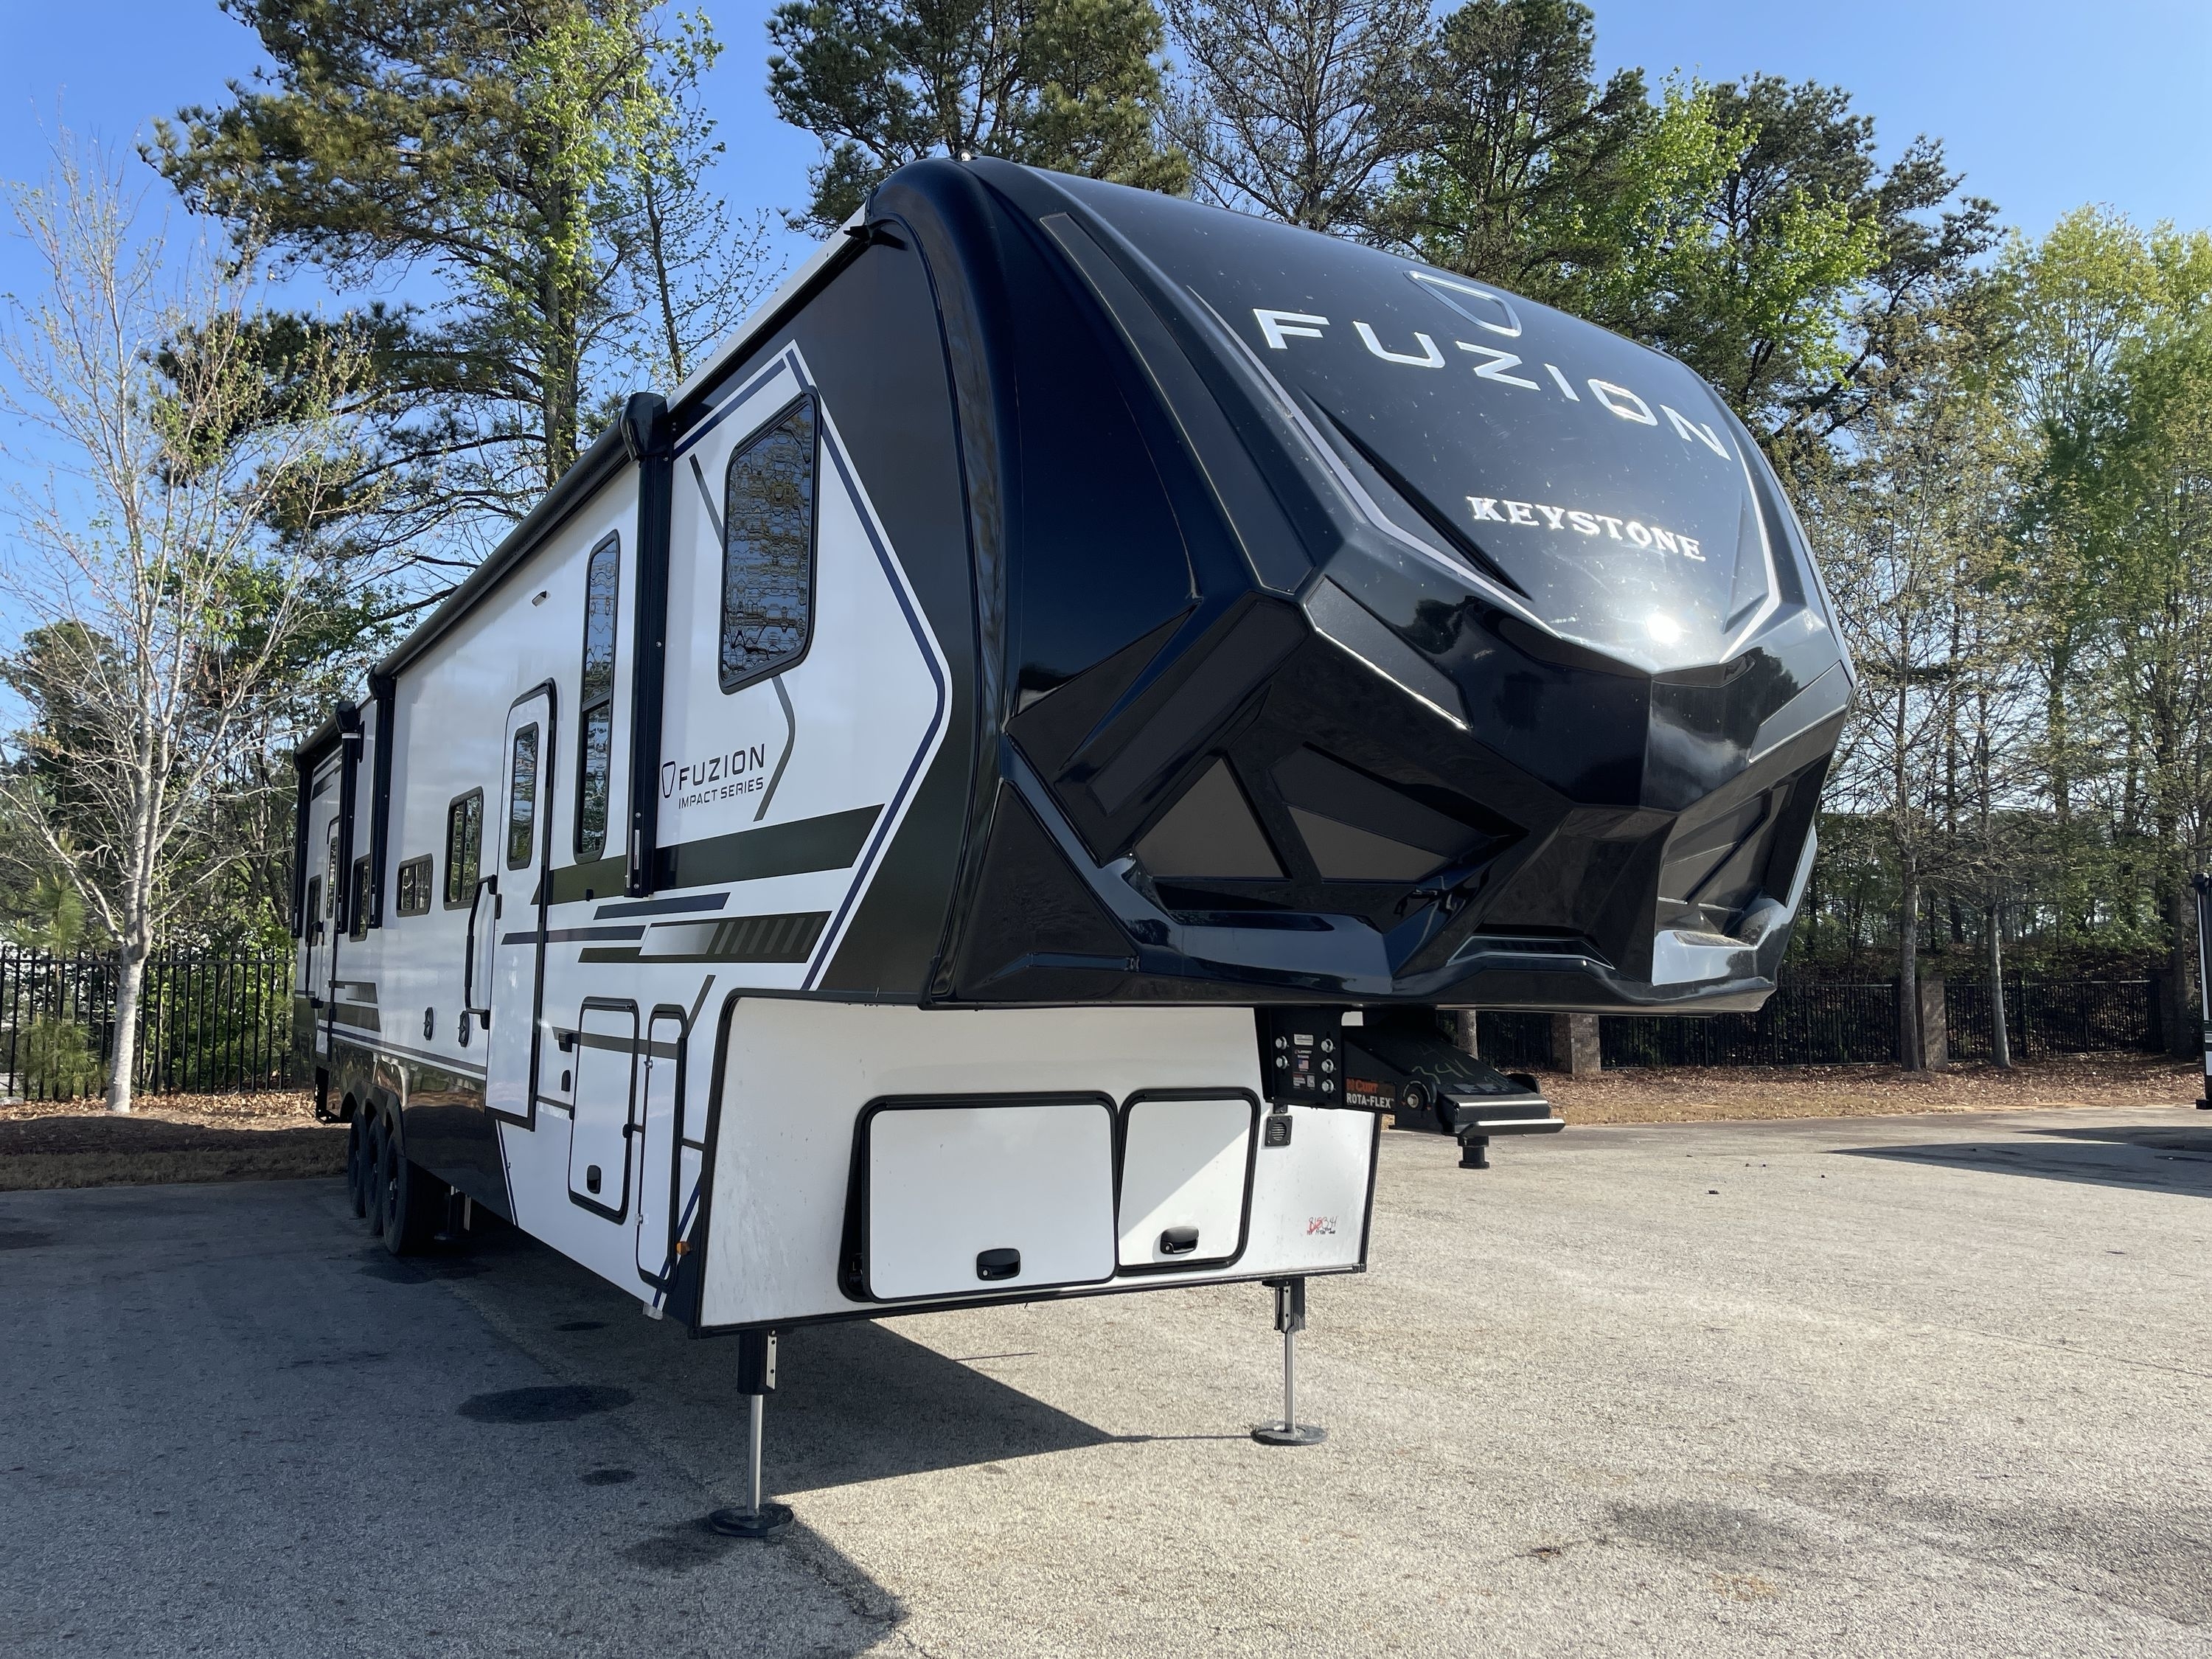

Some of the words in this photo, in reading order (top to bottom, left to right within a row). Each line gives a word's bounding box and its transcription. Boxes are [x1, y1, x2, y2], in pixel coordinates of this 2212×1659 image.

[1253, 309, 1731, 461] FUZION
[1466, 496, 1705, 561] KEYSTONE
[678, 743, 765, 790] FUZION
[678, 789, 717, 810] IMPACT
[720, 776, 763, 799] SERIES
